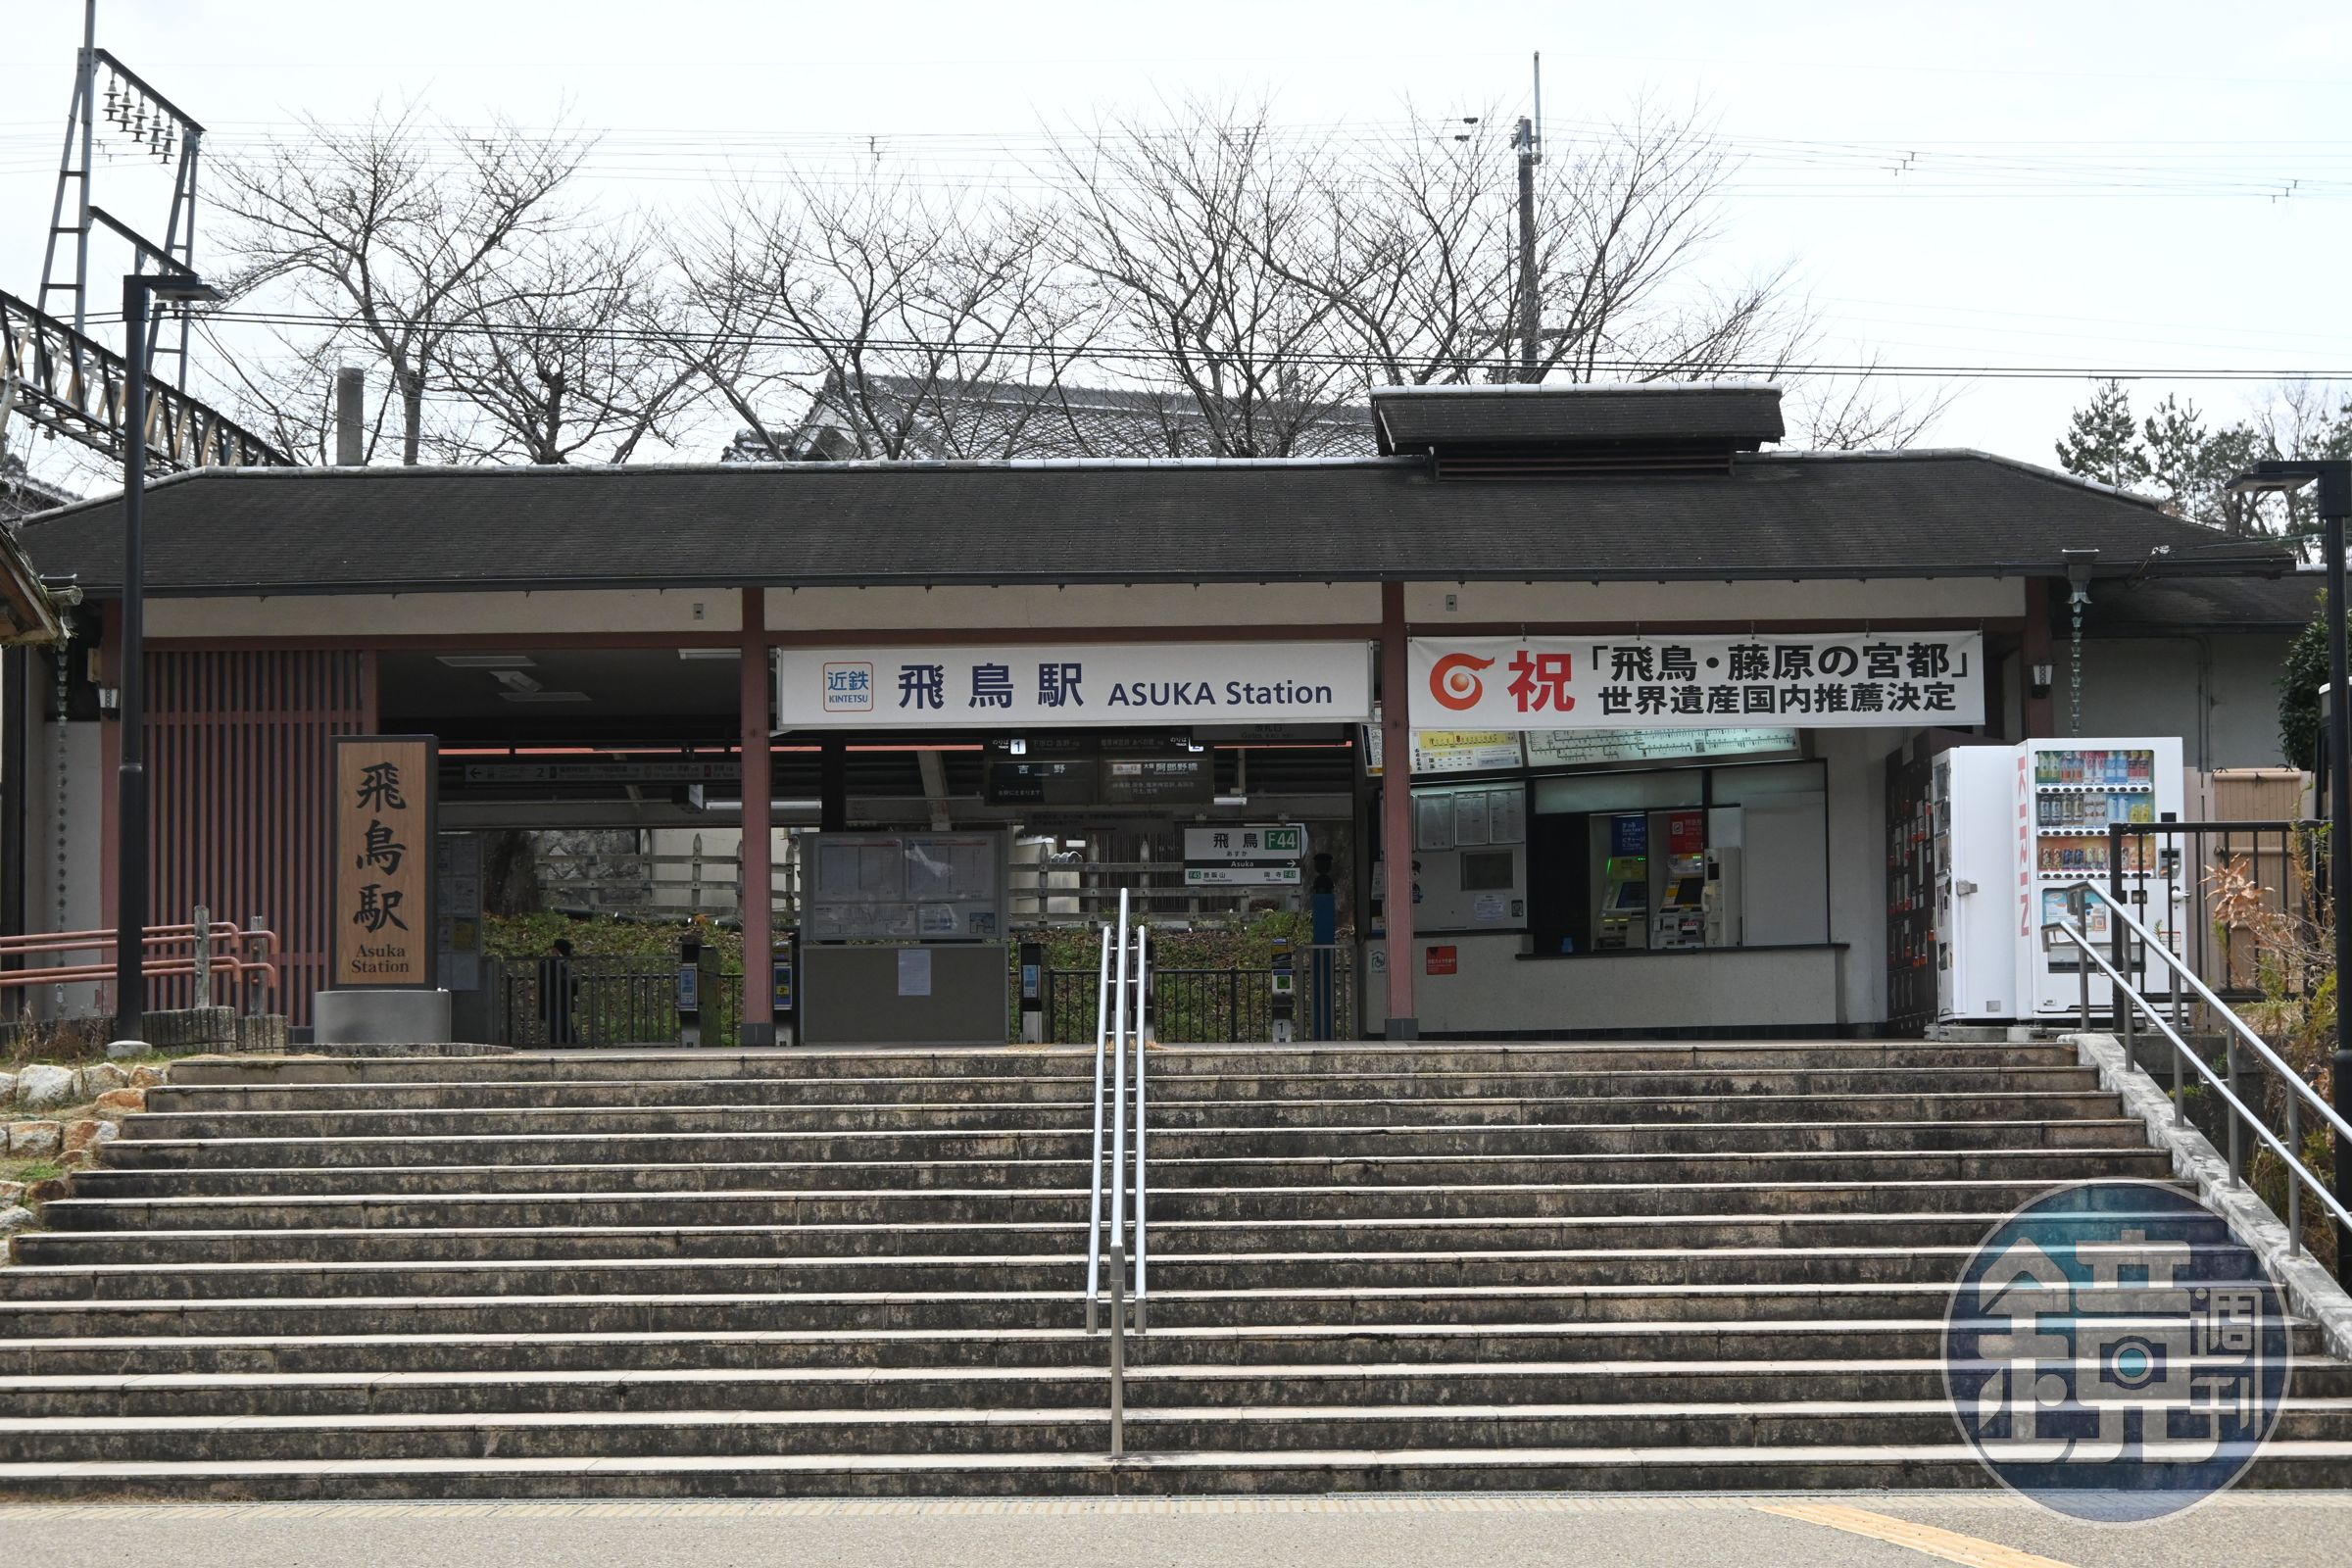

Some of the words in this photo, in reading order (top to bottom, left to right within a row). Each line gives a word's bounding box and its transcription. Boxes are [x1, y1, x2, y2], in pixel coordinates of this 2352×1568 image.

[1592, 644, 1969, 683] 「飛鳥・藤原の宮都」
[827, 671, 869, 692] 近鉄
[898, 662, 1085, 710] 飛鳥駅
[1107, 682, 1216, 707] ASUKA
[1226, 679, 1333, 705] Station
[1508, 650, 1576, 713] 祝
[828, 694, 869, 704] KINTETSU
[1597, 682, 1957, 716] 世界遺産国内推薦決定
[352, 761, 410, 934] 飛鳥駅
[1213, 833, 1258, 849] 飛鳥
[1267, 832, 1297, 848] F44
[2017, 756, 2031, 938] KIRIN
[356, 944, 406, 958] Asuka
[351, 959, 410, 974] Station
[1278, 1022, 1283, 1034] 1
